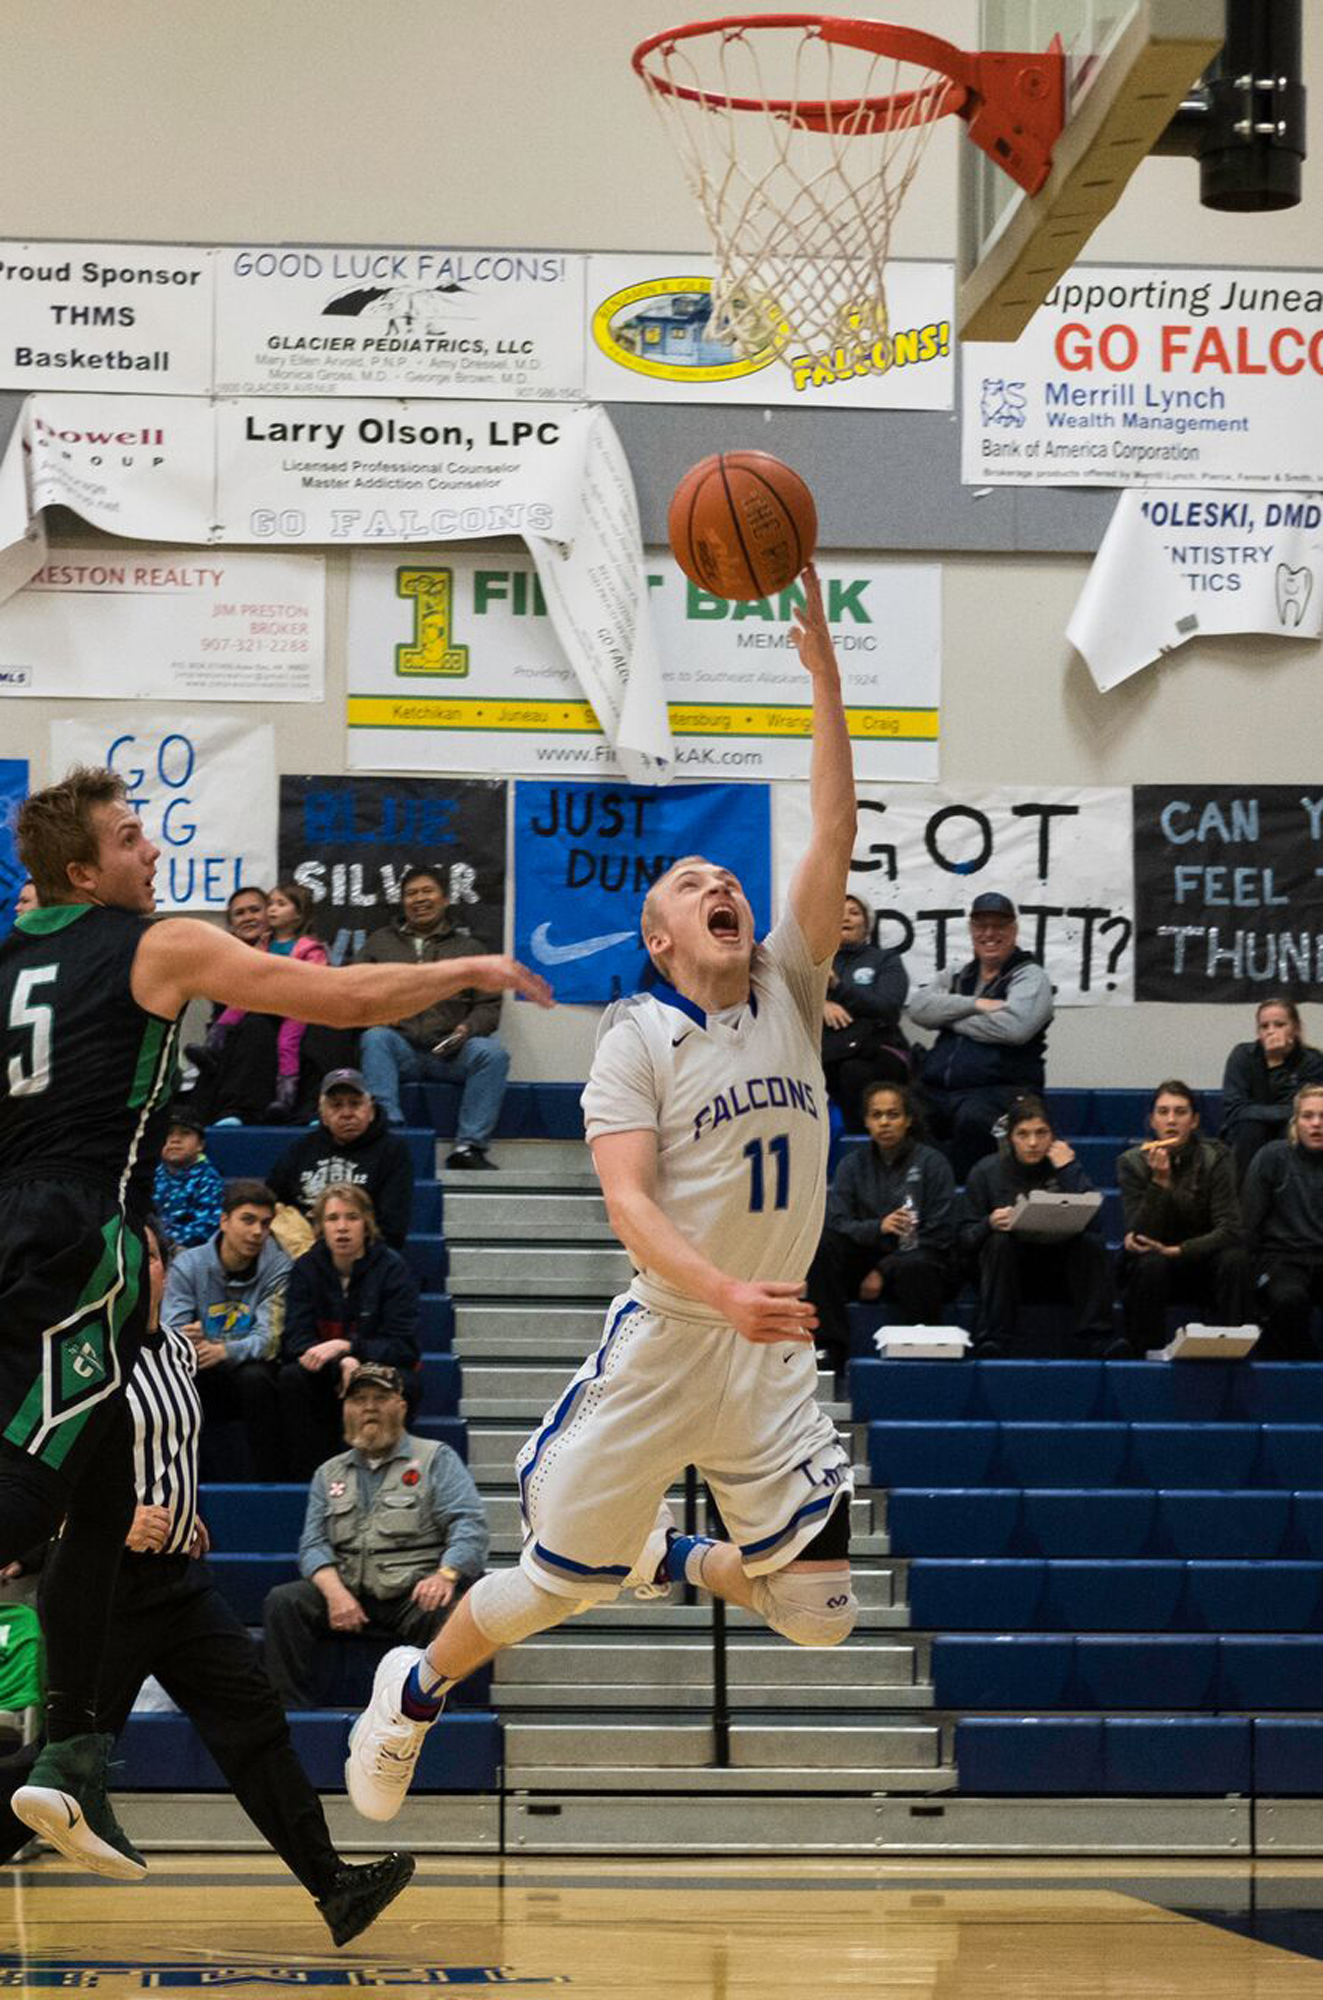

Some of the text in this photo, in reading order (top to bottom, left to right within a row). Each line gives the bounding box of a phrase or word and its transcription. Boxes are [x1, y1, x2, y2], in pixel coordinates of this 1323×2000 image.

[82, 262, 202, 287] Sponsor
[234, 252, 566, 283] GOOD LUCK FALCONS!
[1043, 279, 1212, 317] upporting
[51, 305, 136, 327] THMS
[268, 336, 534, 357] GLACIER PEDIATRICS, LLC
[1054, 323, 1139, 373] GO
[15, 348, 170, 372] Basketball
[1046, 383, 1226, 413] Merrill Lynch
[246, 415, 561, 451] Larry Olson, LPC
[1046, 412, 1250, 434] Wealth Management
[981, 438, 1200, 463] Bank of America Corporation
[283, 460, 521, 475] Licensed Professional Counselor
[302, 476, 503, 490] Master Addiction Counselor
[250, 503, 554, 538] GO FALCONS
[1265, 504, 1322, 529] DMD
[1164, 546, 1275, 564] NTISTRY
[31, 566, 225, 587] RESTON REALTY
[1181, 574, 1241, 591] TICS
[241, 604, 308, 618] PRESTON
[250, 622, 308, 635] BROKER
[737, 633, 800, 649] MEMB
[671, 713, 731, 729] tersburg
[767, 715, 812, 733] Wrang
[863, 716, 899, 733] Craig
[304, 790, 460, 846] BLUE
[532, 789, 657, 838] JUST
[1160, 799, 1259, 844] CAN
[566, 848, 678, 893] DUN
[294, 861, 480, 906] SILVR
[1174, 865, 1290, 907] FEEL
[8, 962, 60, 1097] 5
[693, 1076, 819, 1142] FALCONS
[743, 1132, 789, 1213] 11
